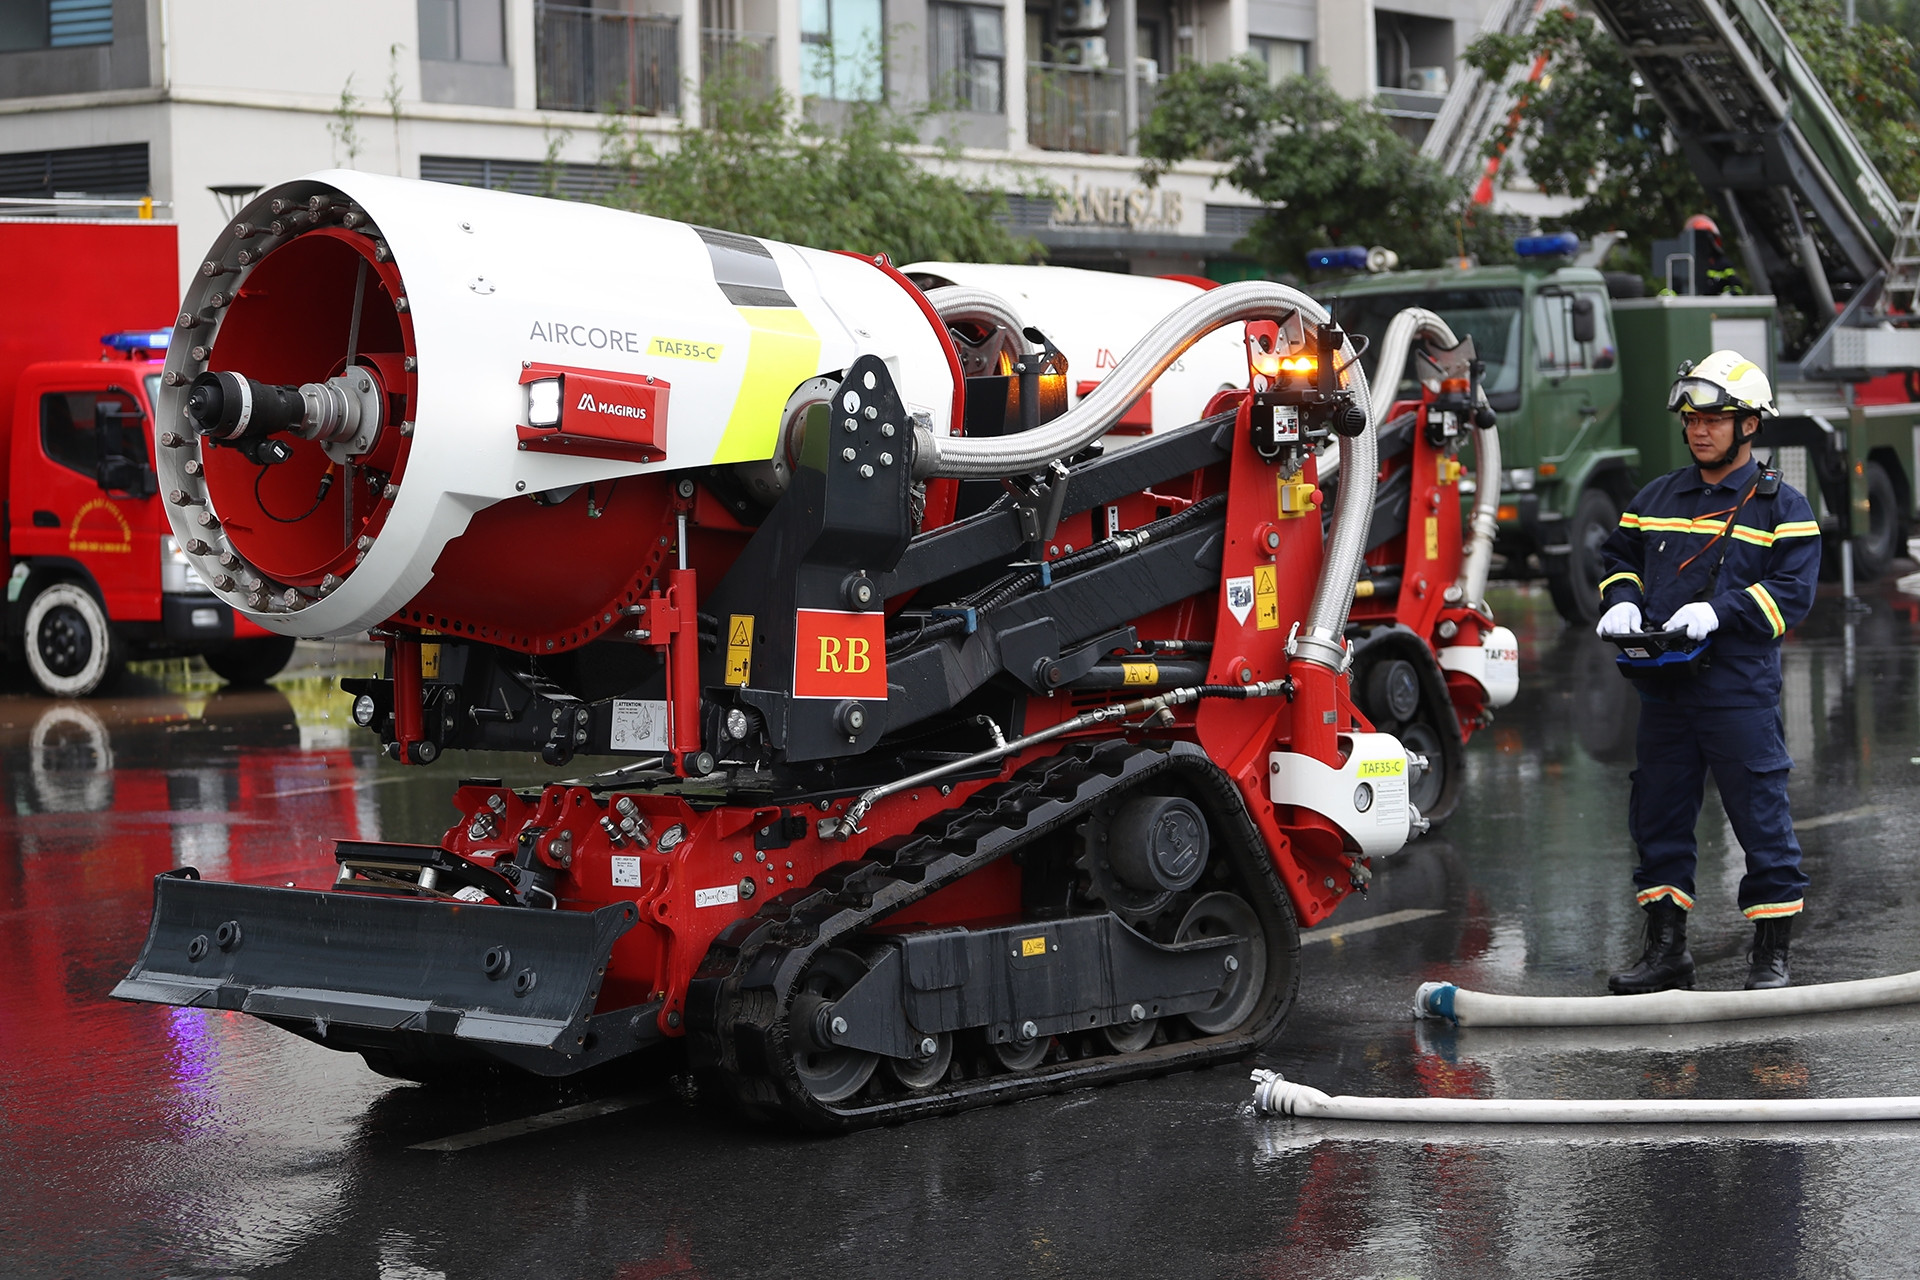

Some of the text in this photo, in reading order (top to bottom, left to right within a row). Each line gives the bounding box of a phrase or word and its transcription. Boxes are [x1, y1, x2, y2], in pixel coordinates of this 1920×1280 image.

[529, 320, 640, 354] AIRCORE
[655, 339, 717, 360] TAF35-C
[598, 401, 647, 420] MAGIRUS
[816, 635, 871, 674] RB
[1362, 761, 1401, 774] TAF35-C
